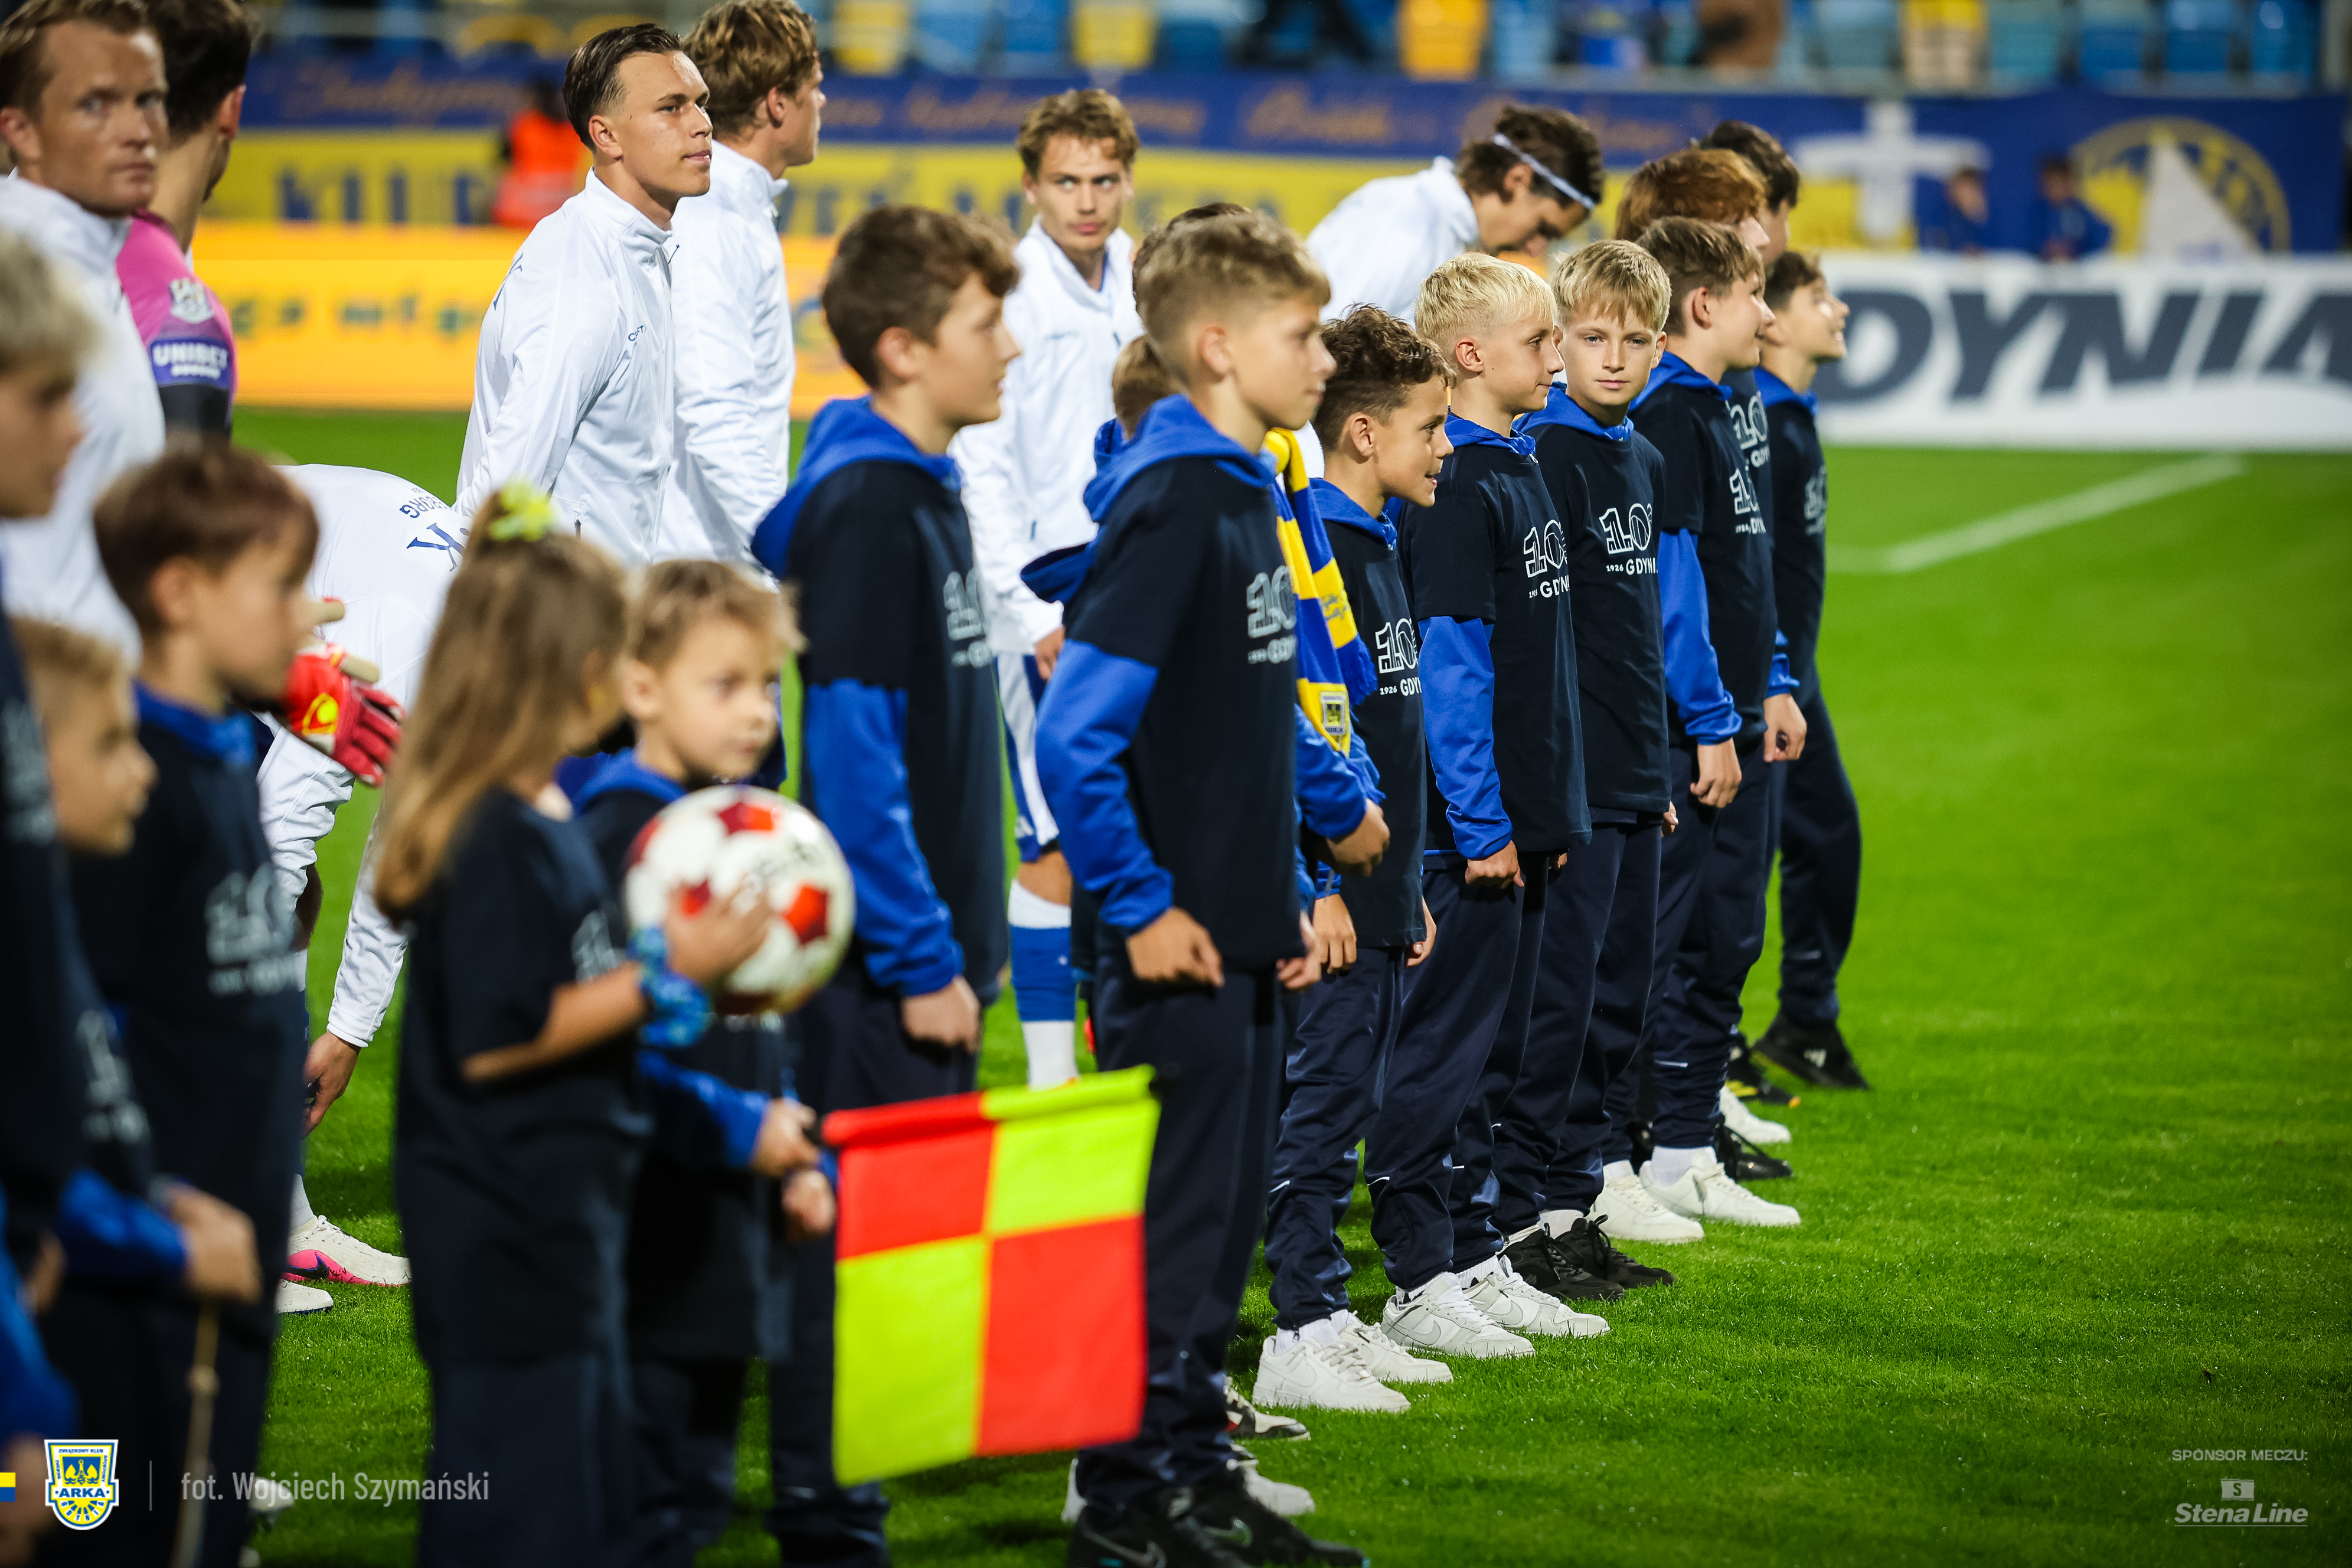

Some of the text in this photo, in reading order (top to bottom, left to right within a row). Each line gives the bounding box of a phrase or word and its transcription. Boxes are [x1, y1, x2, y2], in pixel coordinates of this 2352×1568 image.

[153, 342, 228, 370] UNIBET
[1815, 289, 2352, 405] DYNIA
[1626, 557, 1658, 575] GDYNI
[1379, 685, 1397, 695] 1926
